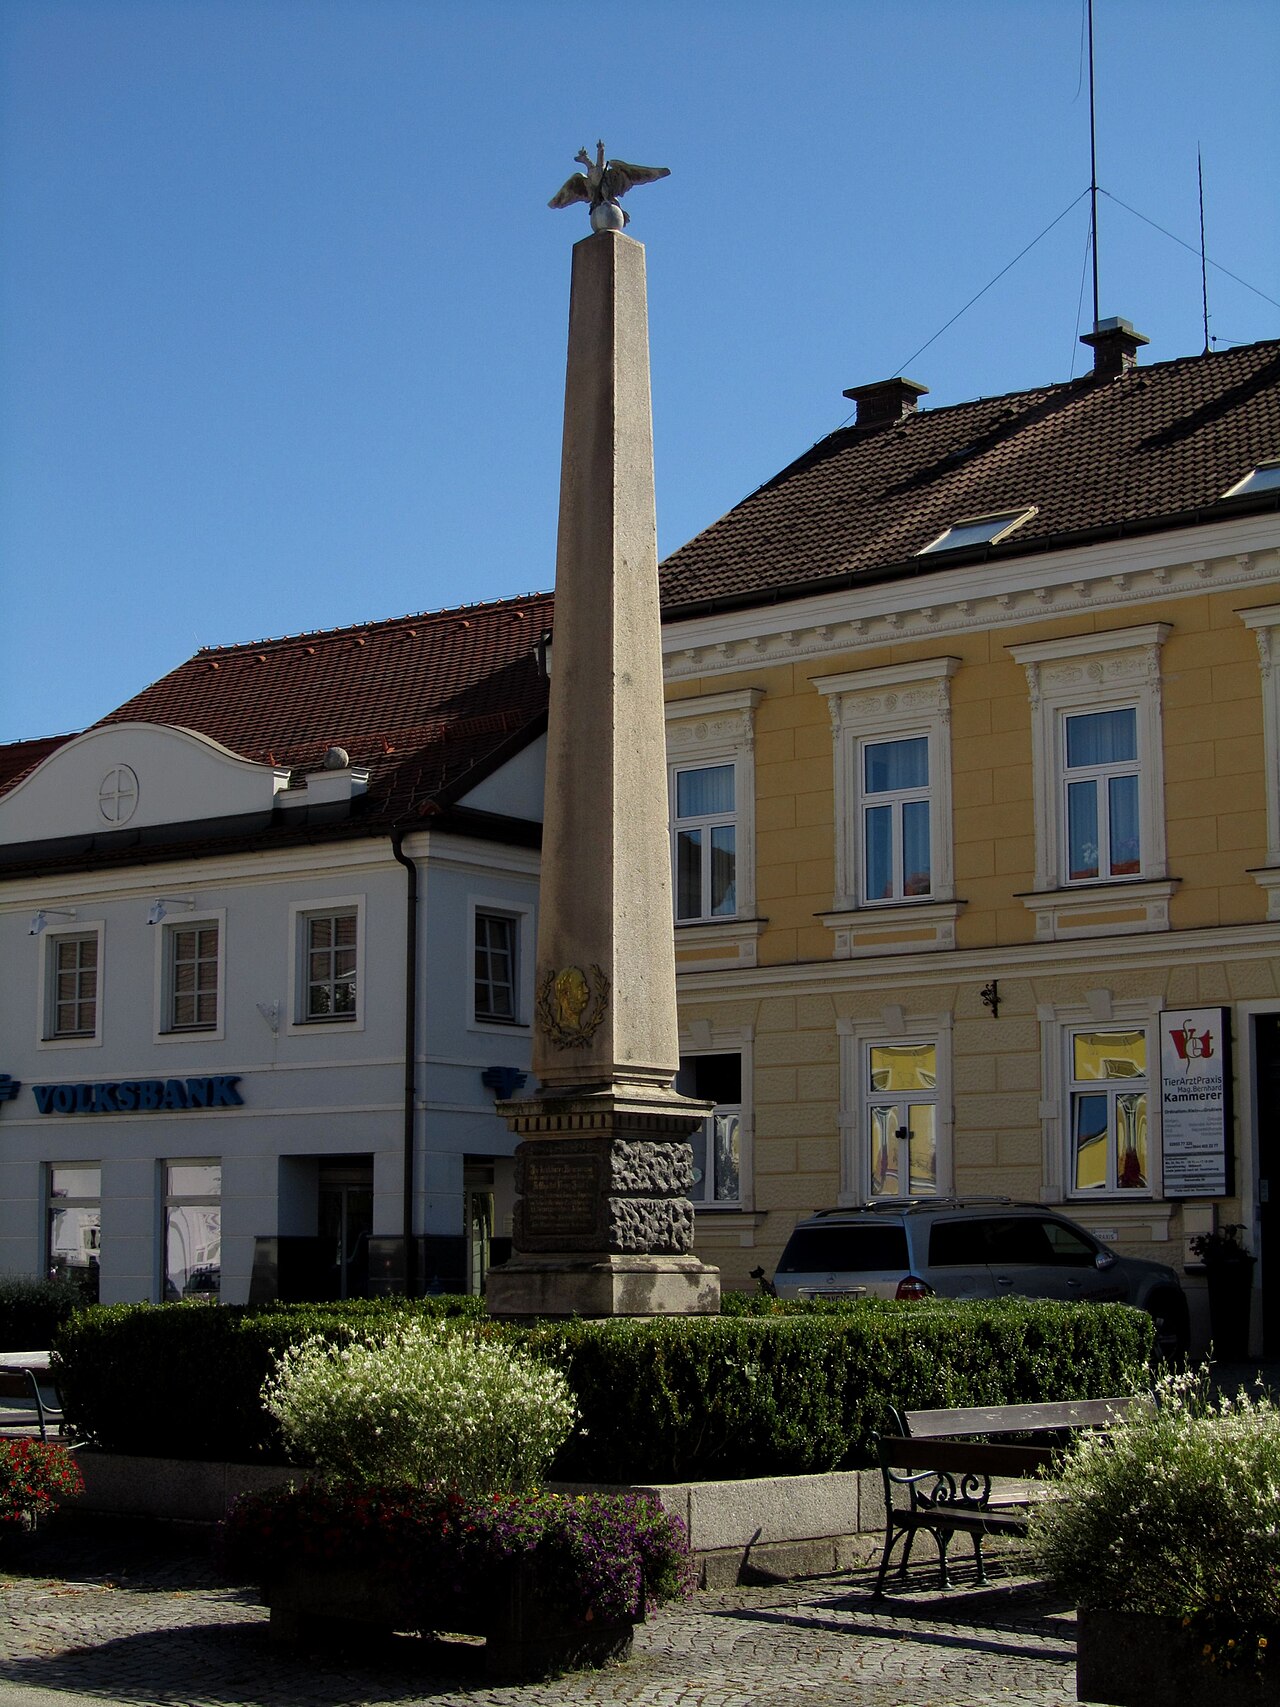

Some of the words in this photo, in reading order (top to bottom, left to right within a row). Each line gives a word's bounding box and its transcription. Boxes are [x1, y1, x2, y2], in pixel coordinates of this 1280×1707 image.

[1169, 1029, 1215, 1059] Vet
[1163, 1075, 1222, 1086] TierArztPraxis
[32, 1076, 244, 1115] VOLKSBANK
[1164, 1092, 1222, 1103] Kammerer
